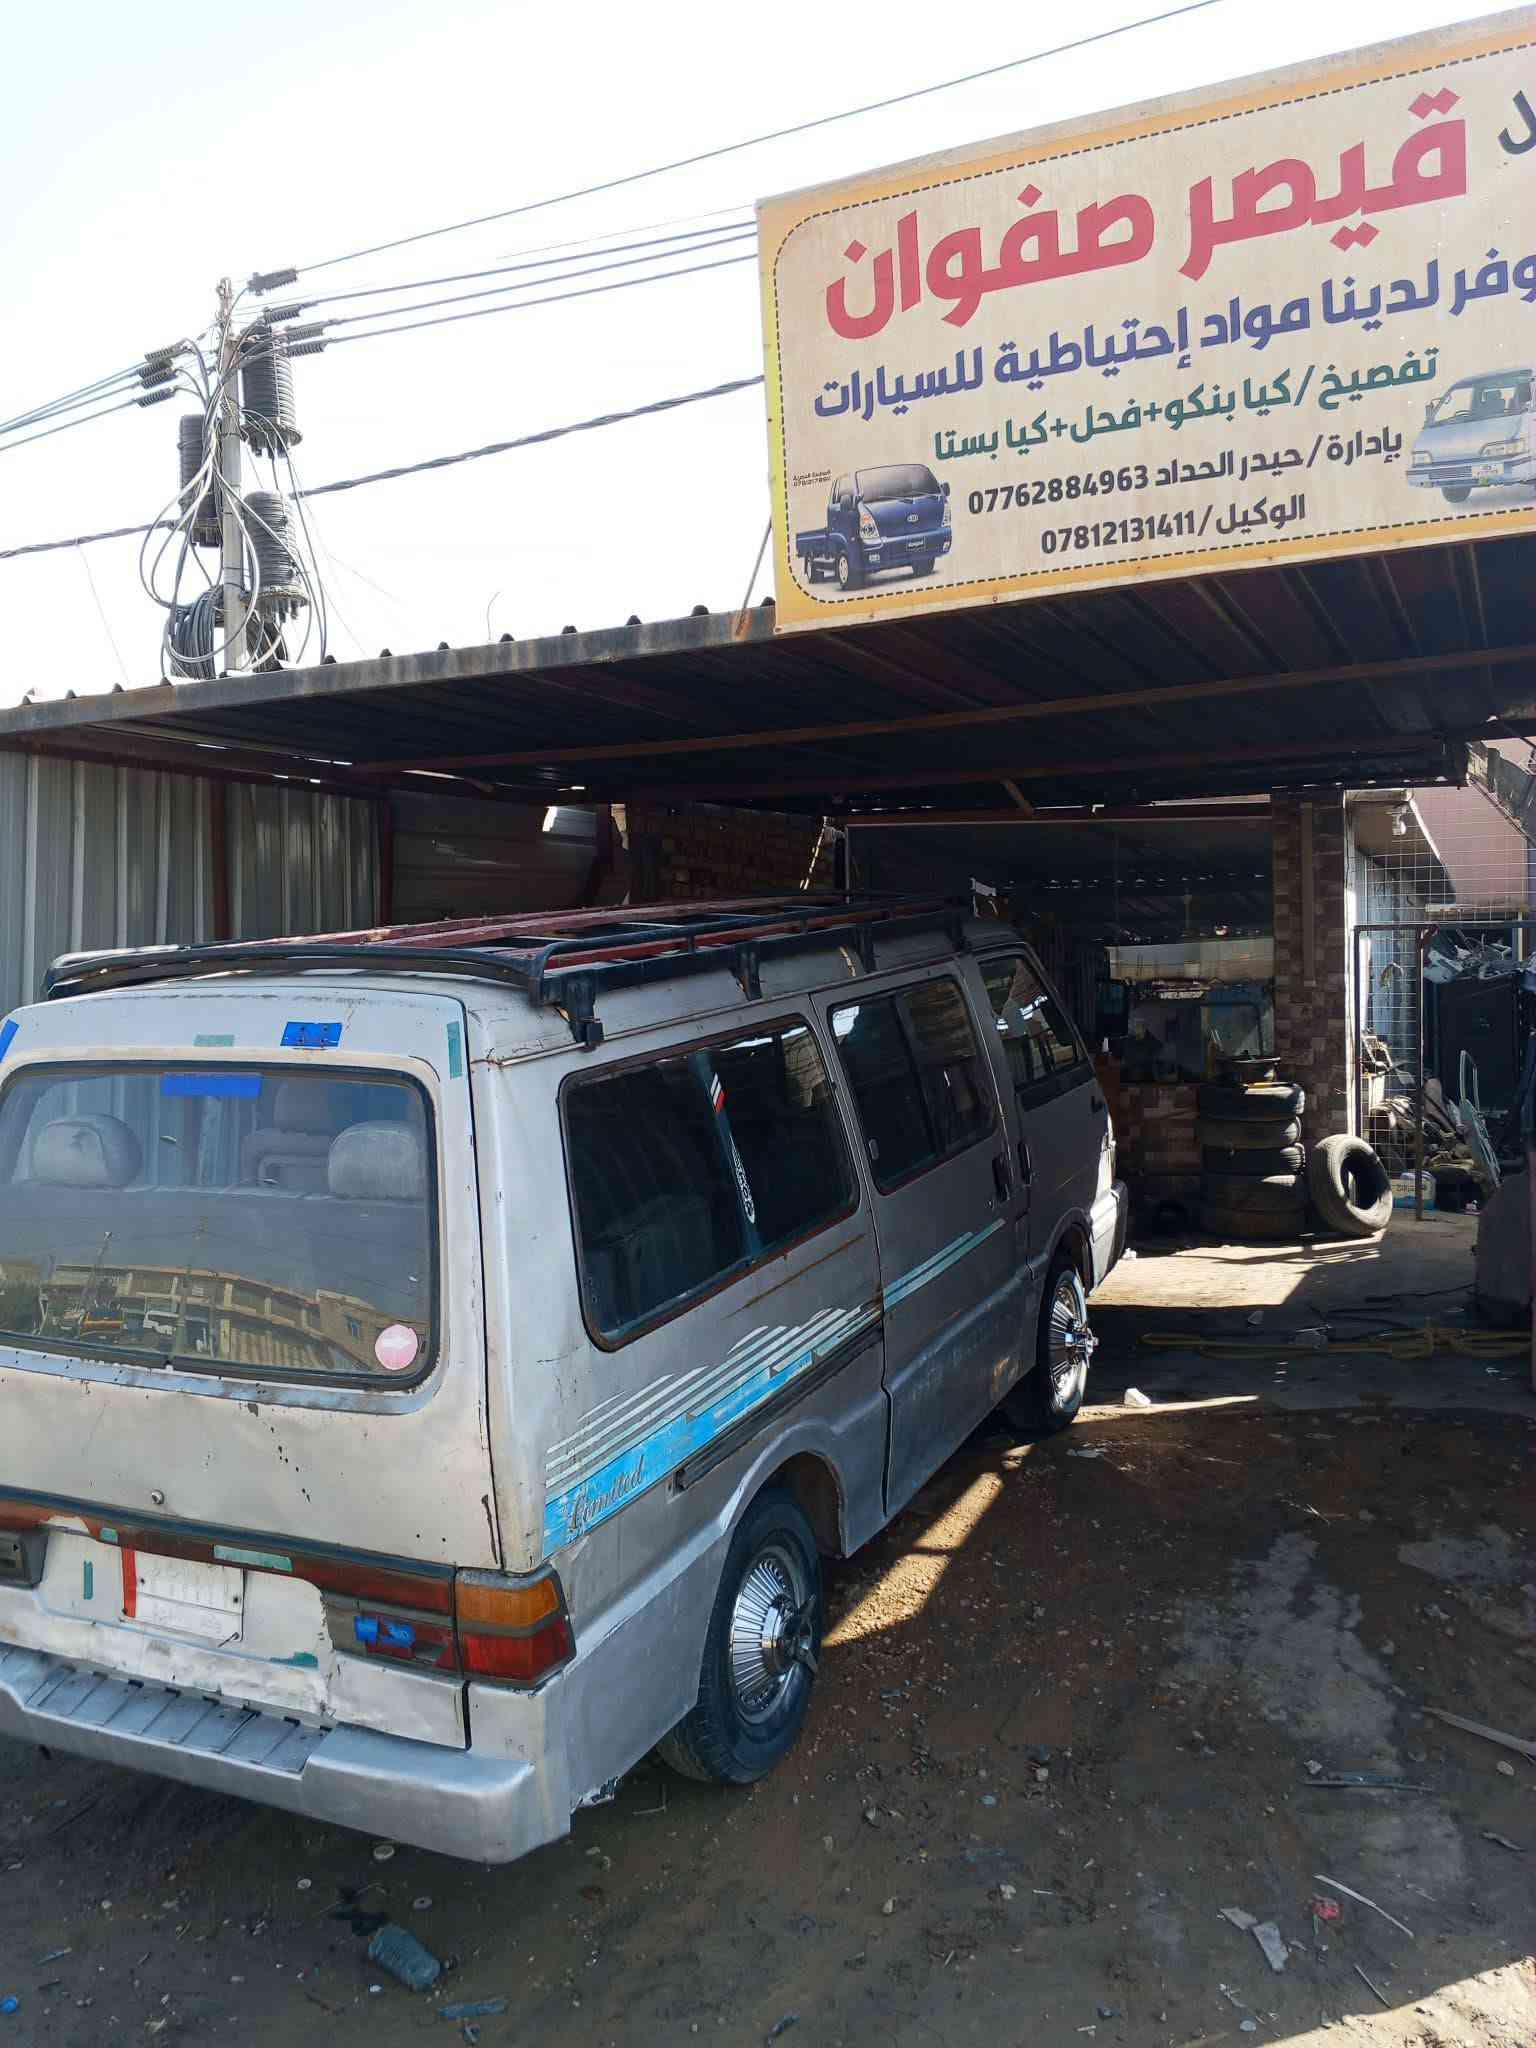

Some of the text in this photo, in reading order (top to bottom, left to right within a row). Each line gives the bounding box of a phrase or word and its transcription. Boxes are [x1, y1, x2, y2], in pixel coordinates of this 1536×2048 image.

[826, 88, 1466, 339] قيصر صفوان
[815, 248, 1536, 421] وفر لدينا مواد إحتياطية للسيارات
[935, 430, 998, 460] بستا
[1155, 450, 1234, 486] الحداد
[969, 465, 1149, 514] 07762884963
